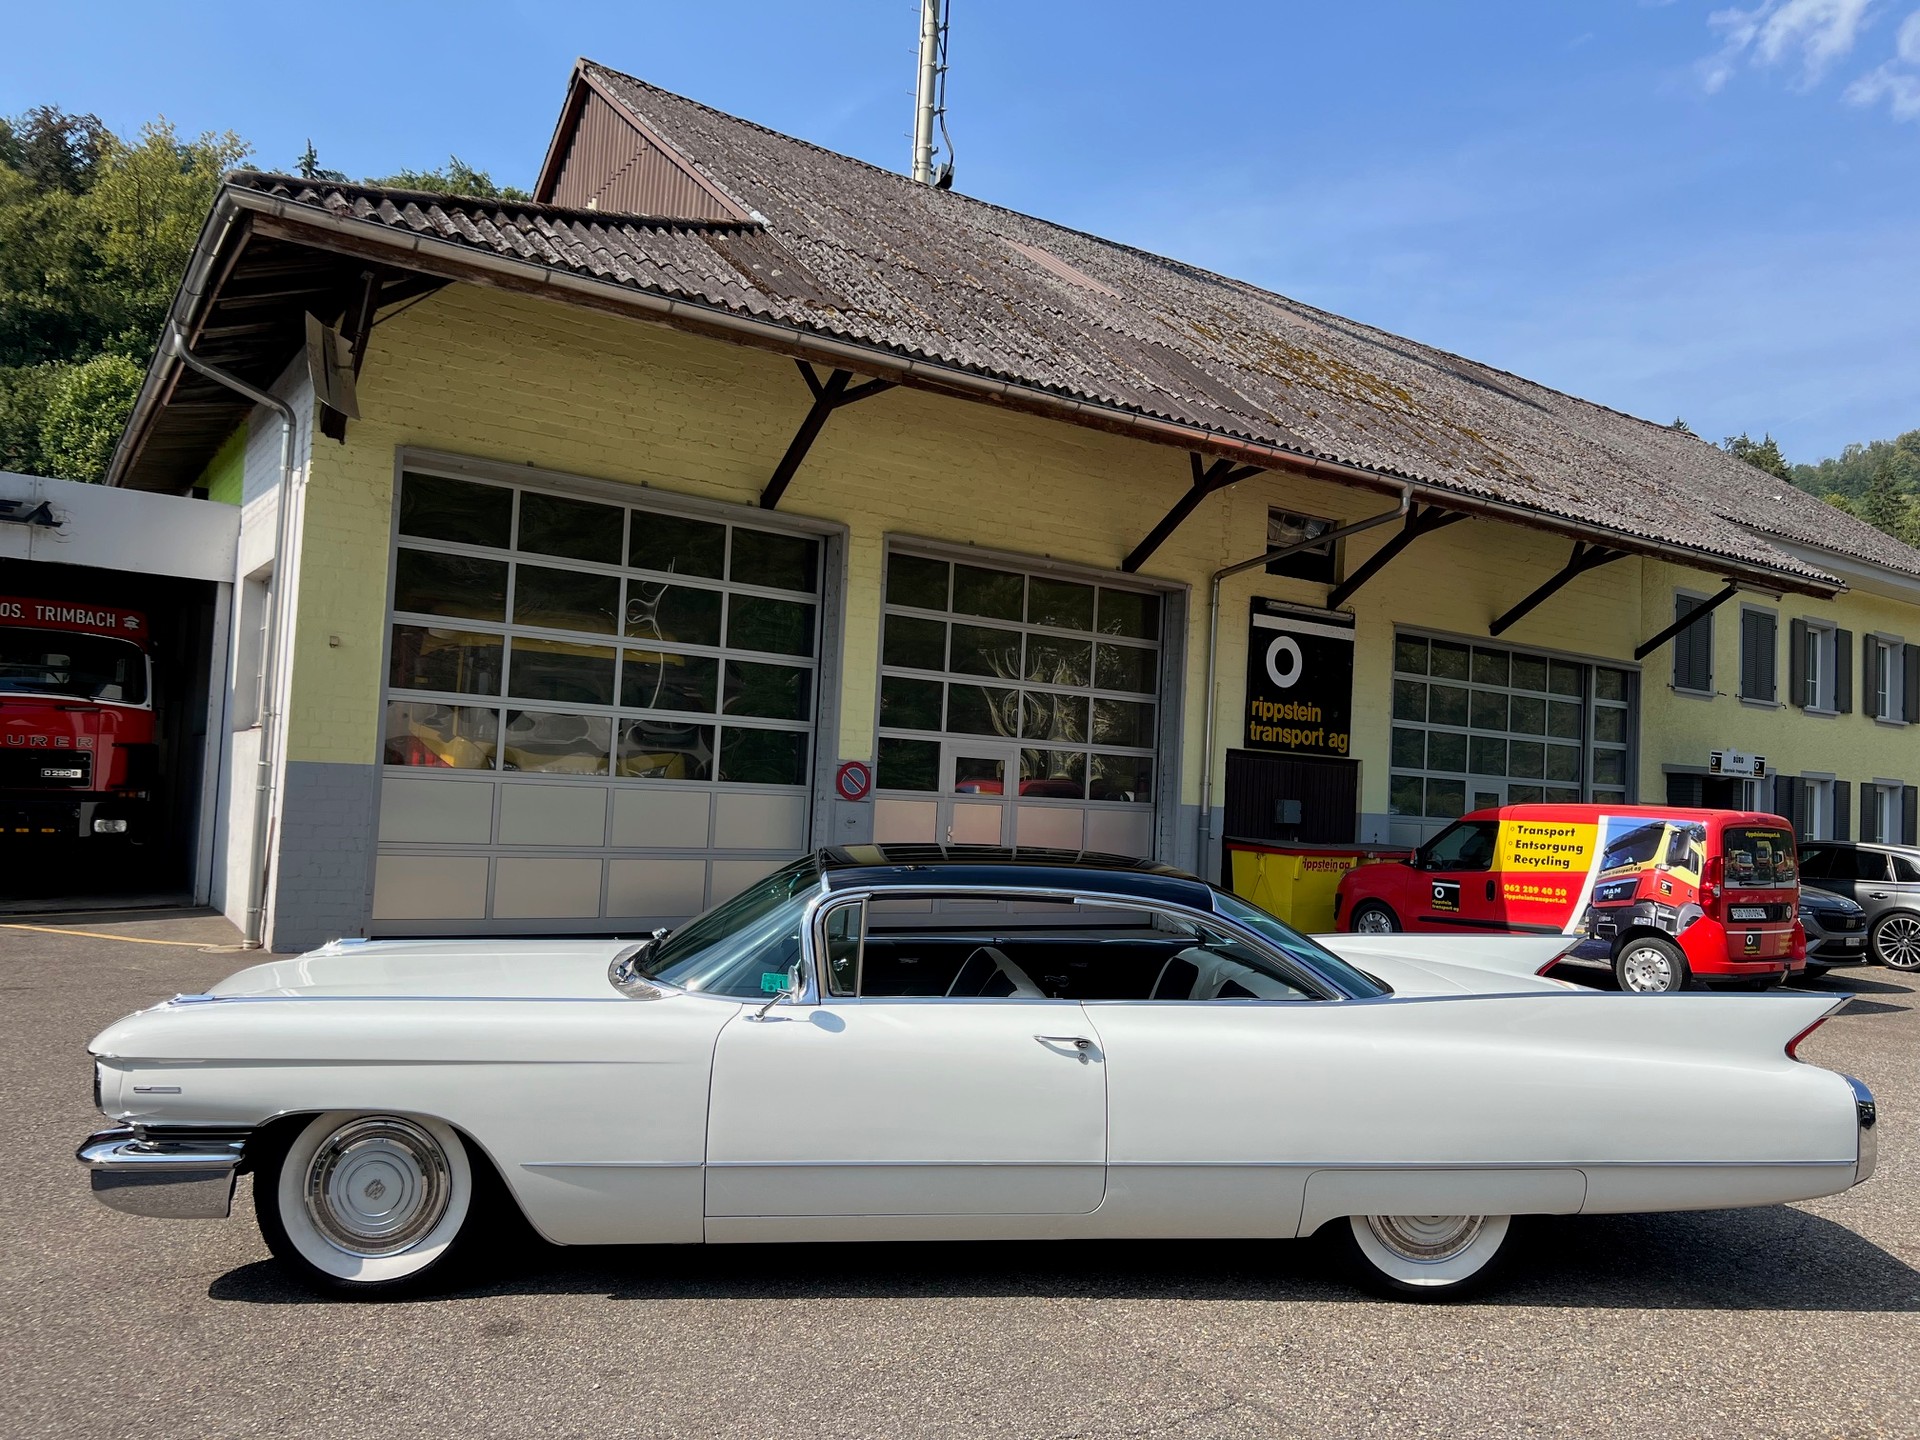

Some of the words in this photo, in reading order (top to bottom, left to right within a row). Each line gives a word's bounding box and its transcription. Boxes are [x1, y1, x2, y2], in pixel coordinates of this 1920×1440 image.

[35, 605, 116, 627] TRIMBACH
[1252, 696, 1322, 722] rippstein
[0, 734, 94, 748] URER
[1250, 721, 1324, 748] transport
[1328, 732, 1348, 753] ag
[1517, 825, 1576, 838] Transport
[1515, 839, 1584, 855] Entsorgung
[1514, 854, 1570, 869] Recycling
[1504, 884, 1520, 892] 062
[1522, 885, 1539, 894] 289
[1541, 887, 1553, 895] 40
[1555, 888, 1567, 896] 50
